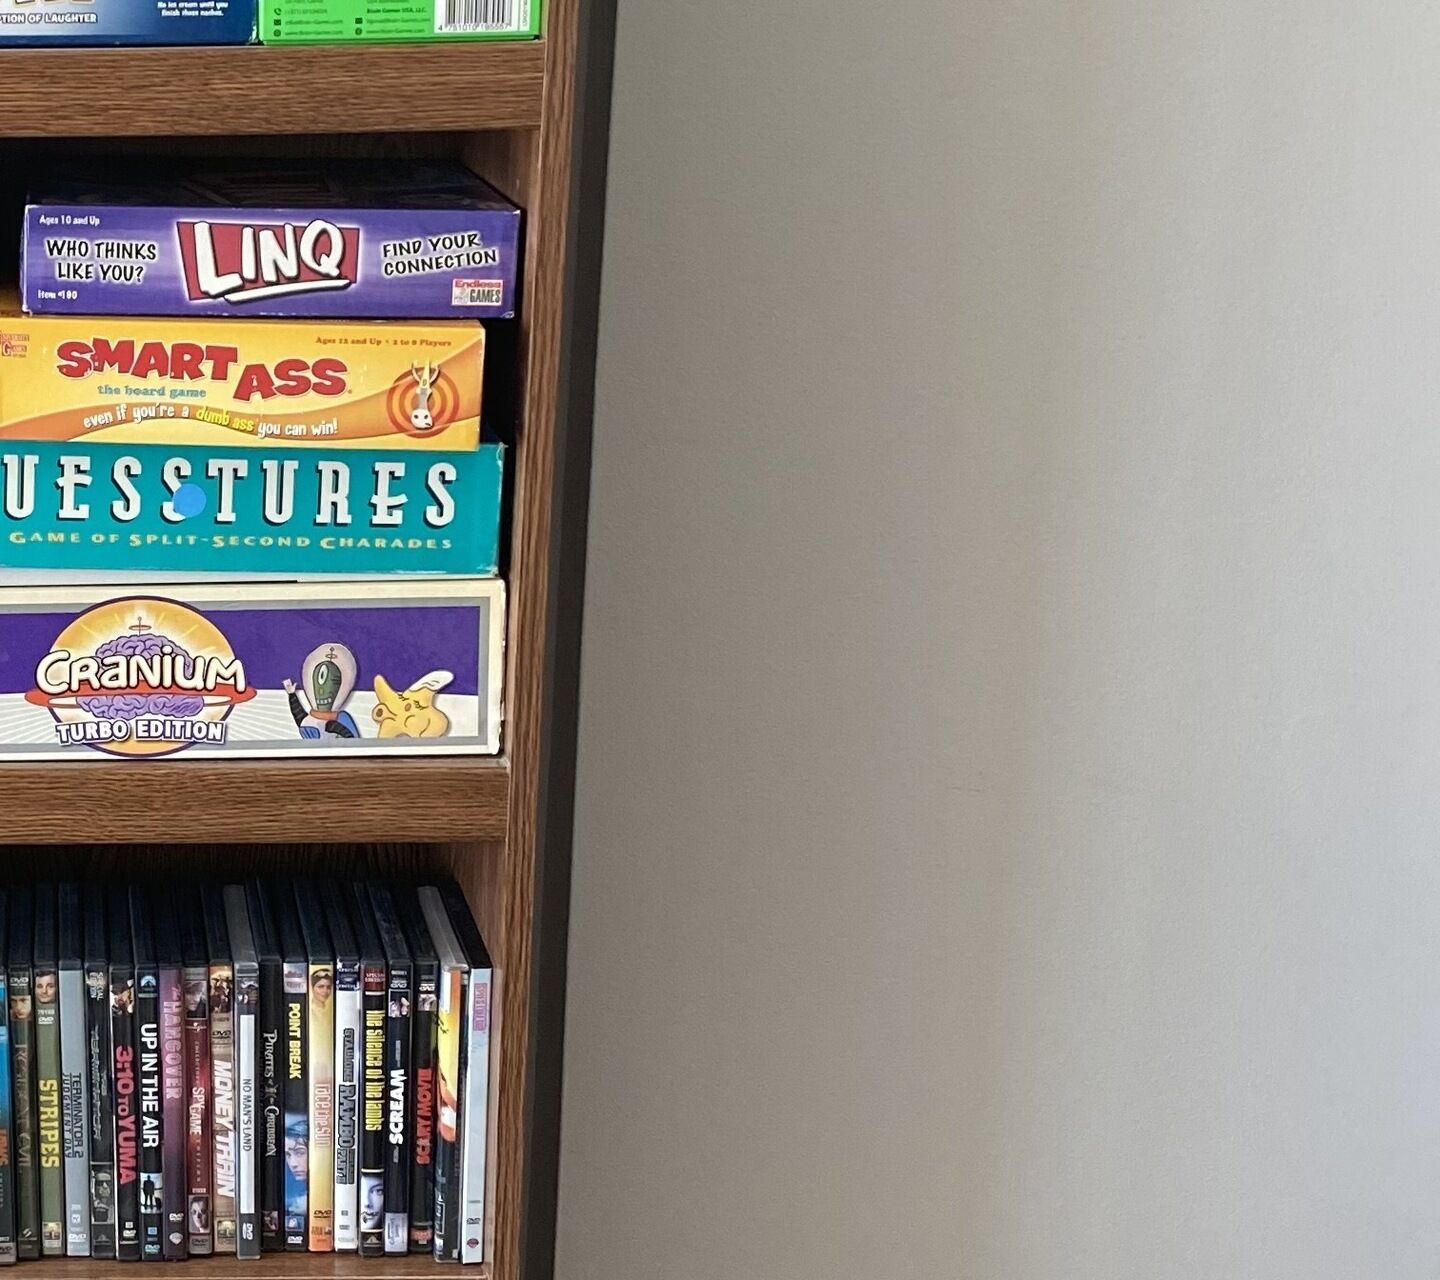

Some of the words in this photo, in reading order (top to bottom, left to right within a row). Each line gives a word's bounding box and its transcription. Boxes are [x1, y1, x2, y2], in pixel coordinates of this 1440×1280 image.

[46, 239, 90, 260] WHO
[94, 241, 157, 261] THINKS
[192, 220, 346, 298] LINQ
[382, 240, 420, 258] FIND
[428, 233, 480, 252] YOUR
[56, 263, 95, 280] LIKE
[99, 264, 143, 283] YOU?
[383, 249, 497, 275] CONNECTION
[56, 337, 238, 379] SMART
[233, 357, 350, 402] ASS
[9, 531, 81, 545] GAME
[91, 533, 120, 545] OF
[129, 534, 311, 549] SPLIT-SECOND
[319, 536, 452, 549] CHARADES
[57, 721, 129, 744] TURBO
[136, 720, 224, 743] EDITION
[289, 1003, 301, 1038] POINT
[141, 1024, 157, 1049] UP
[115, 1046, 134, 1094] 3:10
[142, 1054, 157, 1071] IN
[289, 1040, 302, 1078] BREAK
[118, 1097, 129, 1115] TO
[142, 1075, 158, 1112] THE
[389, 1069, 407, 1145] SCREAM
[40, 1080, 60, 1168] STRIPES
[143, 1116, 159, 1147] AIR
[118, 1115, 137, 1184] YUMA
